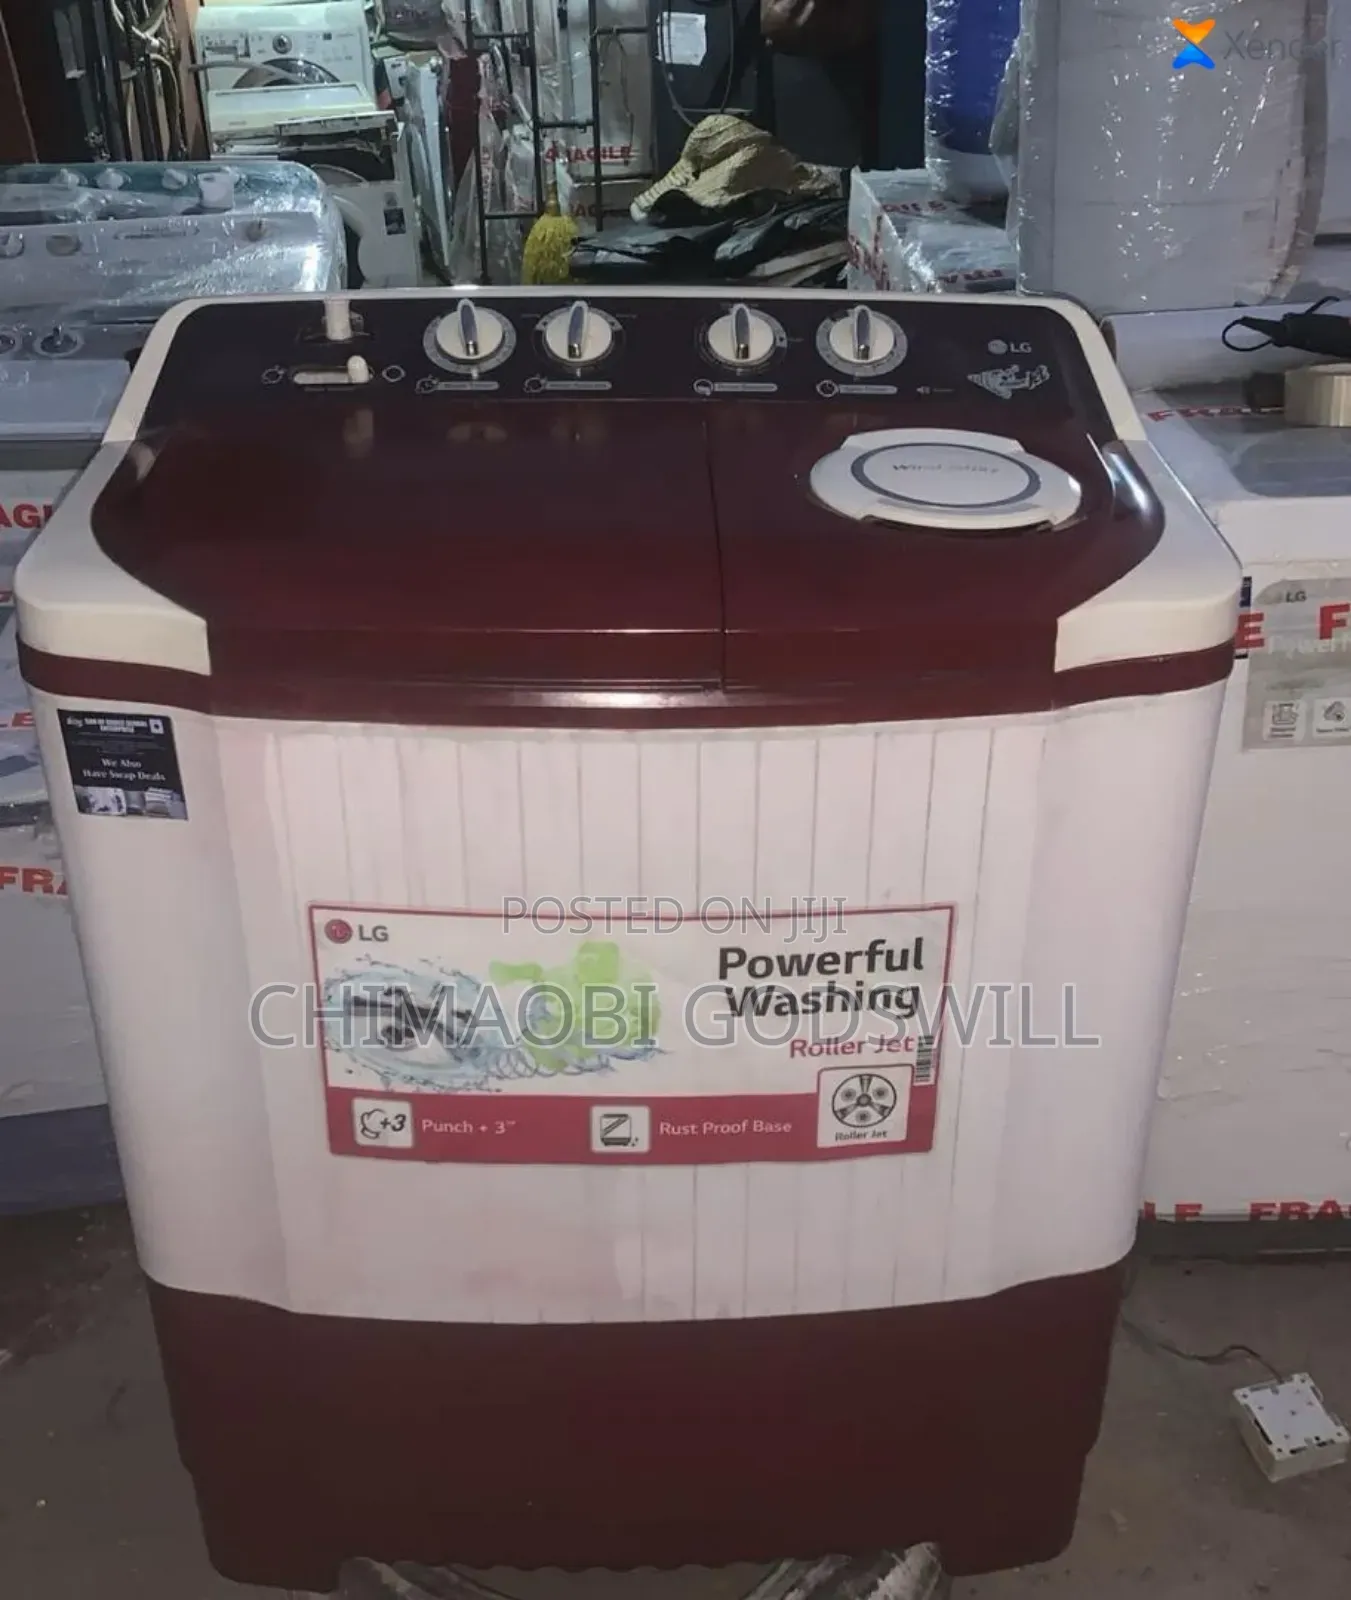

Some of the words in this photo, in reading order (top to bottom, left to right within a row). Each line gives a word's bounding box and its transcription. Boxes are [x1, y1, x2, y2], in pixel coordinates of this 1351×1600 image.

[1010, 342, 1032, 353] LG
[1286, 590, 1307, 603] LG
[358, 924, 389, 942] LG
[718, 937, 924, 980] Powerful
[725, 980, 920, 1020] Washing
[790, 1036, 866, 1059] Roller
[874, 1034, 915, 1054] Jet
[422, 1119, 473, 1134] Punch
[659, 1121, 697, 1136] Rust
[702, 1120, 747, 1135] Proof
[753, 1120, 792, 1133] Base
[835, 1131, 867, 1142] Roller
